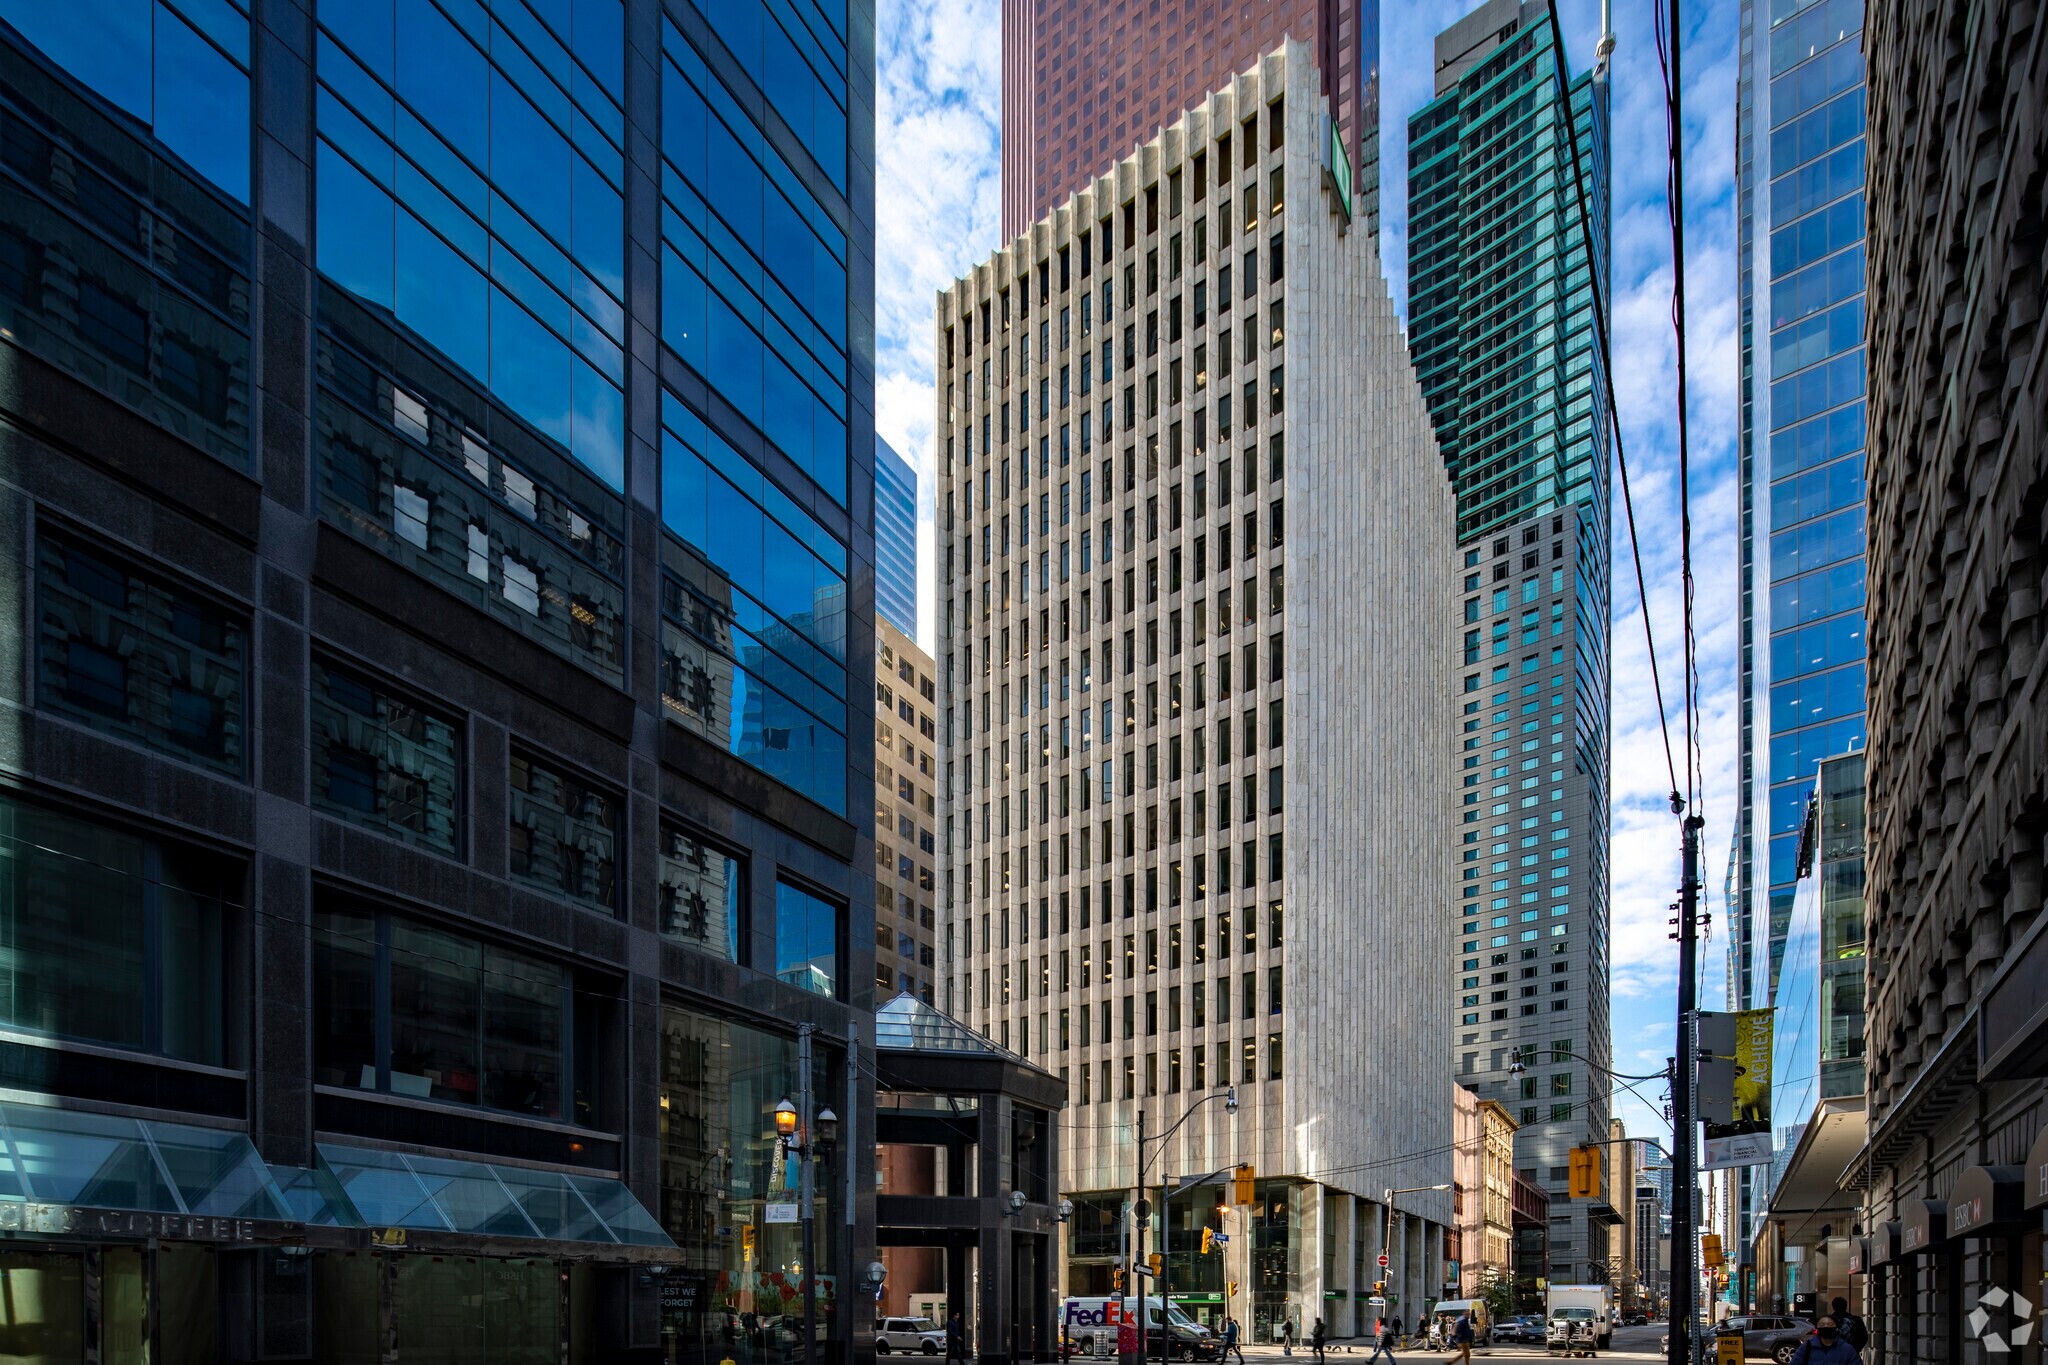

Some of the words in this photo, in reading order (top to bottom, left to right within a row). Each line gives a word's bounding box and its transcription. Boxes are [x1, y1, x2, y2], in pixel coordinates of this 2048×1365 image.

[1333, 132, 1350, 203] TD
[1751, 1014, 1773, 1085] ACHIEVE
[770, 1138, 784, 1183] DISCOVER
[1954, 1200, 1972, 1231] HSBC
[1905, 1226, 1917, 1249] HSBC
[660, 1287, 681, 1296] LEST
[681, 1287, 697, 1296] WE
[660, 1298, 695, 1307] FORGET
[1796, 1294, 1803, 1303] 8
[1066, 1301, 1137, 1327] FedEx
